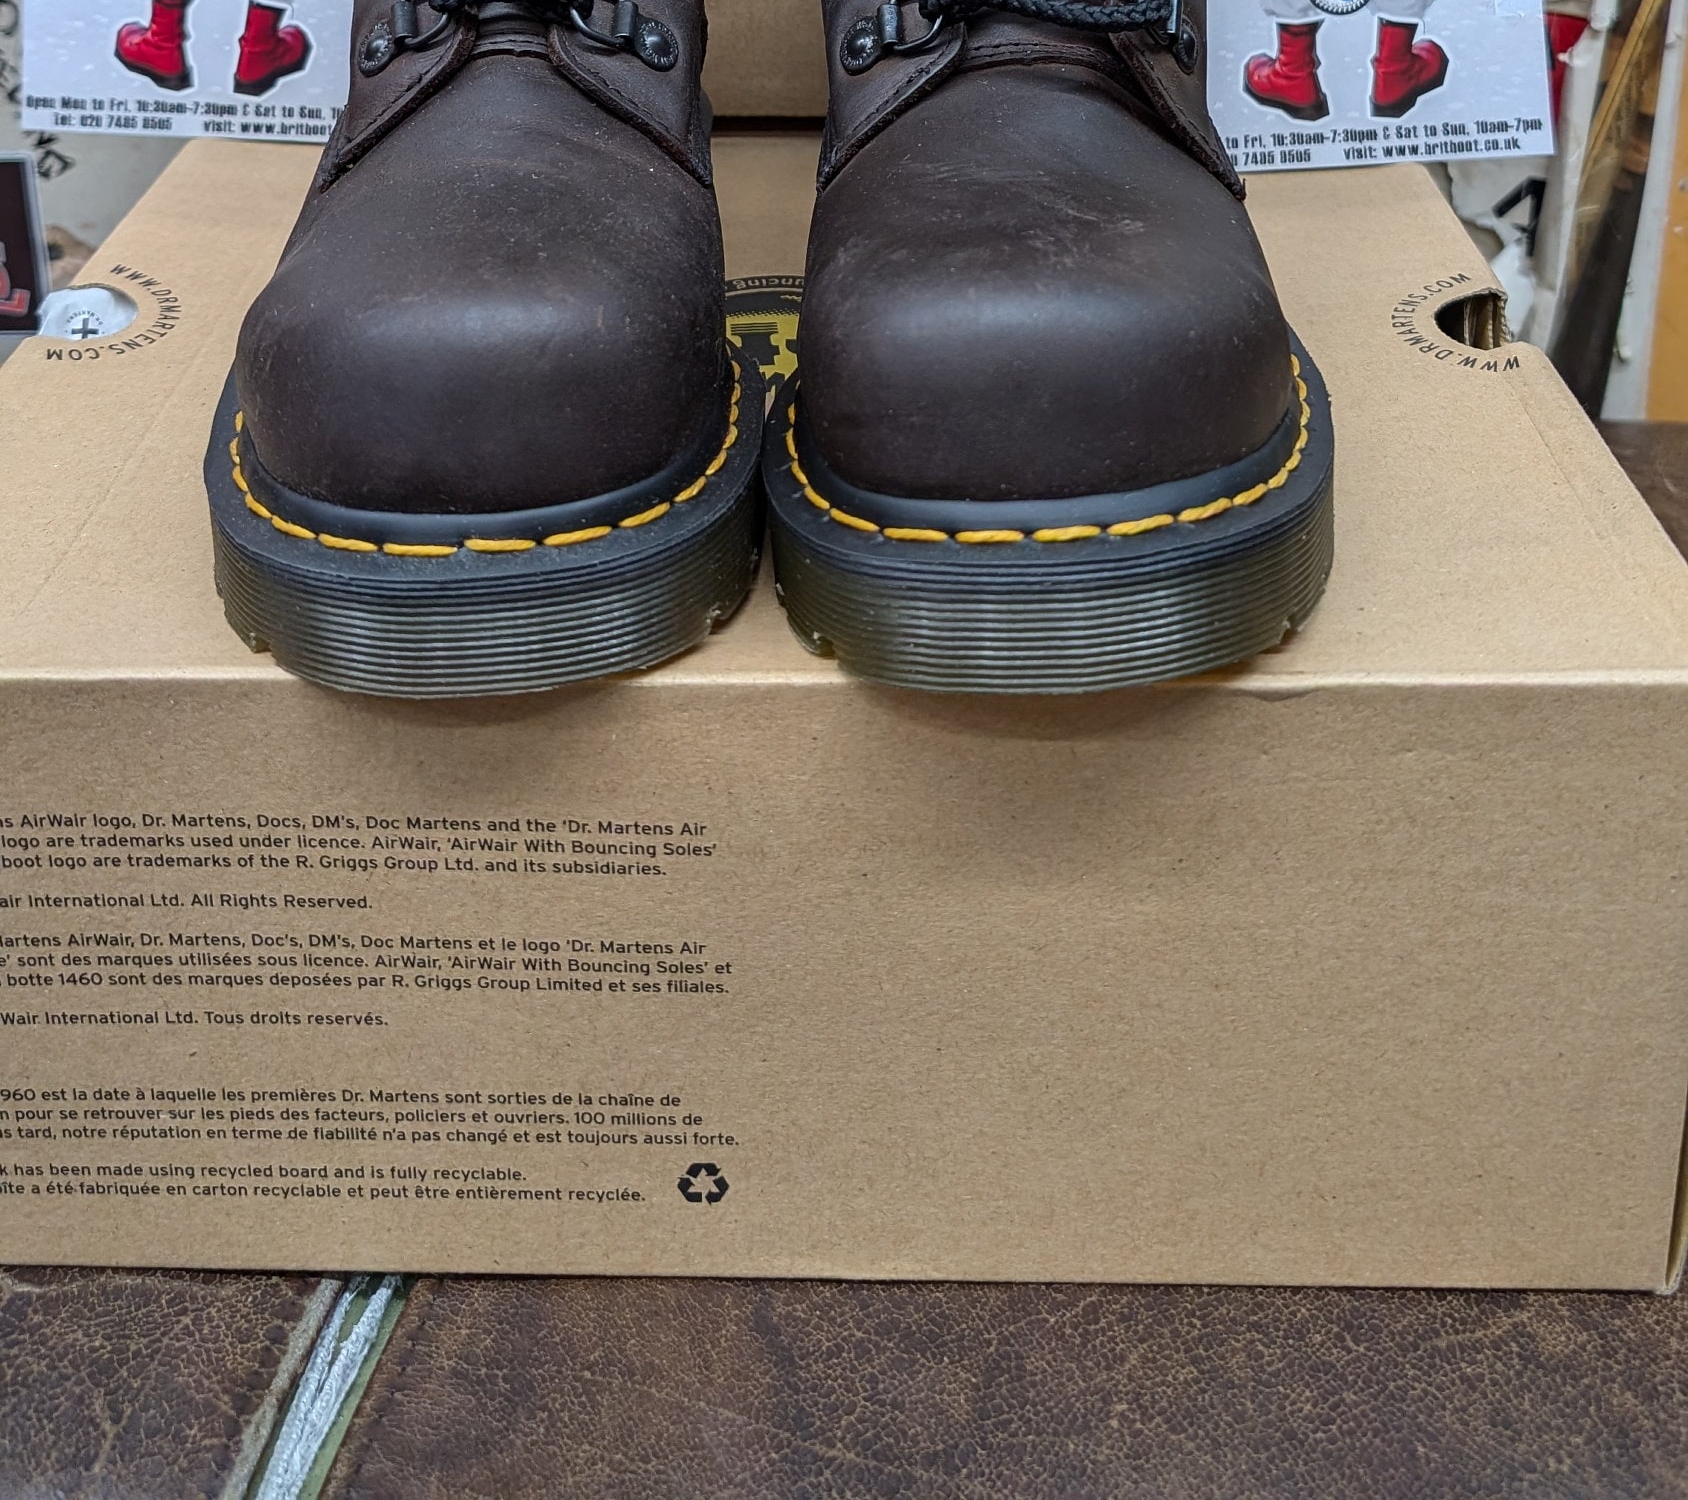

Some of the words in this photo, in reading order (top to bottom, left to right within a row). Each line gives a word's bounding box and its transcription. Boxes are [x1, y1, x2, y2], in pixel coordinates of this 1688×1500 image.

[26, 95, 56, 109] Open
[92, 97, 104, 110] to
[254, 104, 276, 117] Sat
[282, 105, 294, 118] to
[1226, 136, 1238, 149] to
[1395, 124, 1418, 139] Sat
[1424, 123, 1437, 137] to
[1474, 117, 1542, 134] 10am-7pm
[1382, 137, 1521, 157] www.britboot.co.uk
[46, 263, 182, 361] WWW.DRMARTENS.COM
[1391, 273, 1520, 373] WWW.DRMARTENS.COM
[20, 813, 87, 830] AirWair
[92, 813, 136, 830] logo,
[141, 813, 166, 828] Dr.
[171, 813, 251, 830] Martens,
[256, 814, 306, 831] Docs,
[365, 815, 400, 830] Doc
[406, 816, 482, 831] Martens
[487, 818, 521, 832] and
[525, 818, 557, 833] the
[598, 820, 674, 836] Martens
[679, 822, 708, 836] Air
[0, 834, 40, 851] logo
[46, 836, 75, 848] are
[79, 833, 185, 848] trademarks
[190, 834, 234, 848] used
[238, 834, 292, 848] under
[297, 834, 366, 849] licence.
[371, 835, 441, 853] AirWair,
[523, 838, 566, 853] With
[571, 840, 657, 859] Bouncing
[1, 854, 43, 869] boot
[48, 854, 87, 871] logo
[92, 856, 122, 868] are
[126, 853, 232, 868] trademarks
[237, 854, 255, 868] of
[259, 854, 290, 868] the
[295, 854, 314, 869] R.
[319, 854, 379, 873] Griggs
[383, 855, 439, 874] Group
[444, 857, 480, 872] Ltd.
[484, 858, 518, 873] and
[523, 858, 547, 873] its
[552, 860, 667, 876] subsidiaries.
[27, 893, 145, 908] International
[150, 893, 185, 907] Ltd.
[190, 893, 214, 908] All
[219, 893, 278, 910] Rights
[283, 894, 373, 909] Reserved.
[13, 1163, 44, 1177] has
[49, 1162, 92, 1176] been
[96, 1163, 144, 1176] made
[148, 1163, 195, 1180] using
[200, 1163, 274, 1180] recycled
[278, 1164, 329, 1179] board
[333, 1165, 365, 1179] and
[370, 1165, 385, 1180] is
[389, 1165, 428, 1183] fully
[433, 1167, 527, 1183] recyclable.
[31, 1184, 41, 1195] a
[46, 1180, 74, 1195] été
[78, 1181, 161, 1198] fabriquée
[166, 1185, 187, 1196] en
[192, 1182, 248, 1197] carton
[253, 1183, 342, 1200] recyclable
[347, 1184, 365, 1198] et
[370, 1185, 409, 1201] peut
[414, 1184, 450, 1199] être
[455, 1185, 563, 1201] entièrement
[568, 1187, 646, 1204] recyclée.
